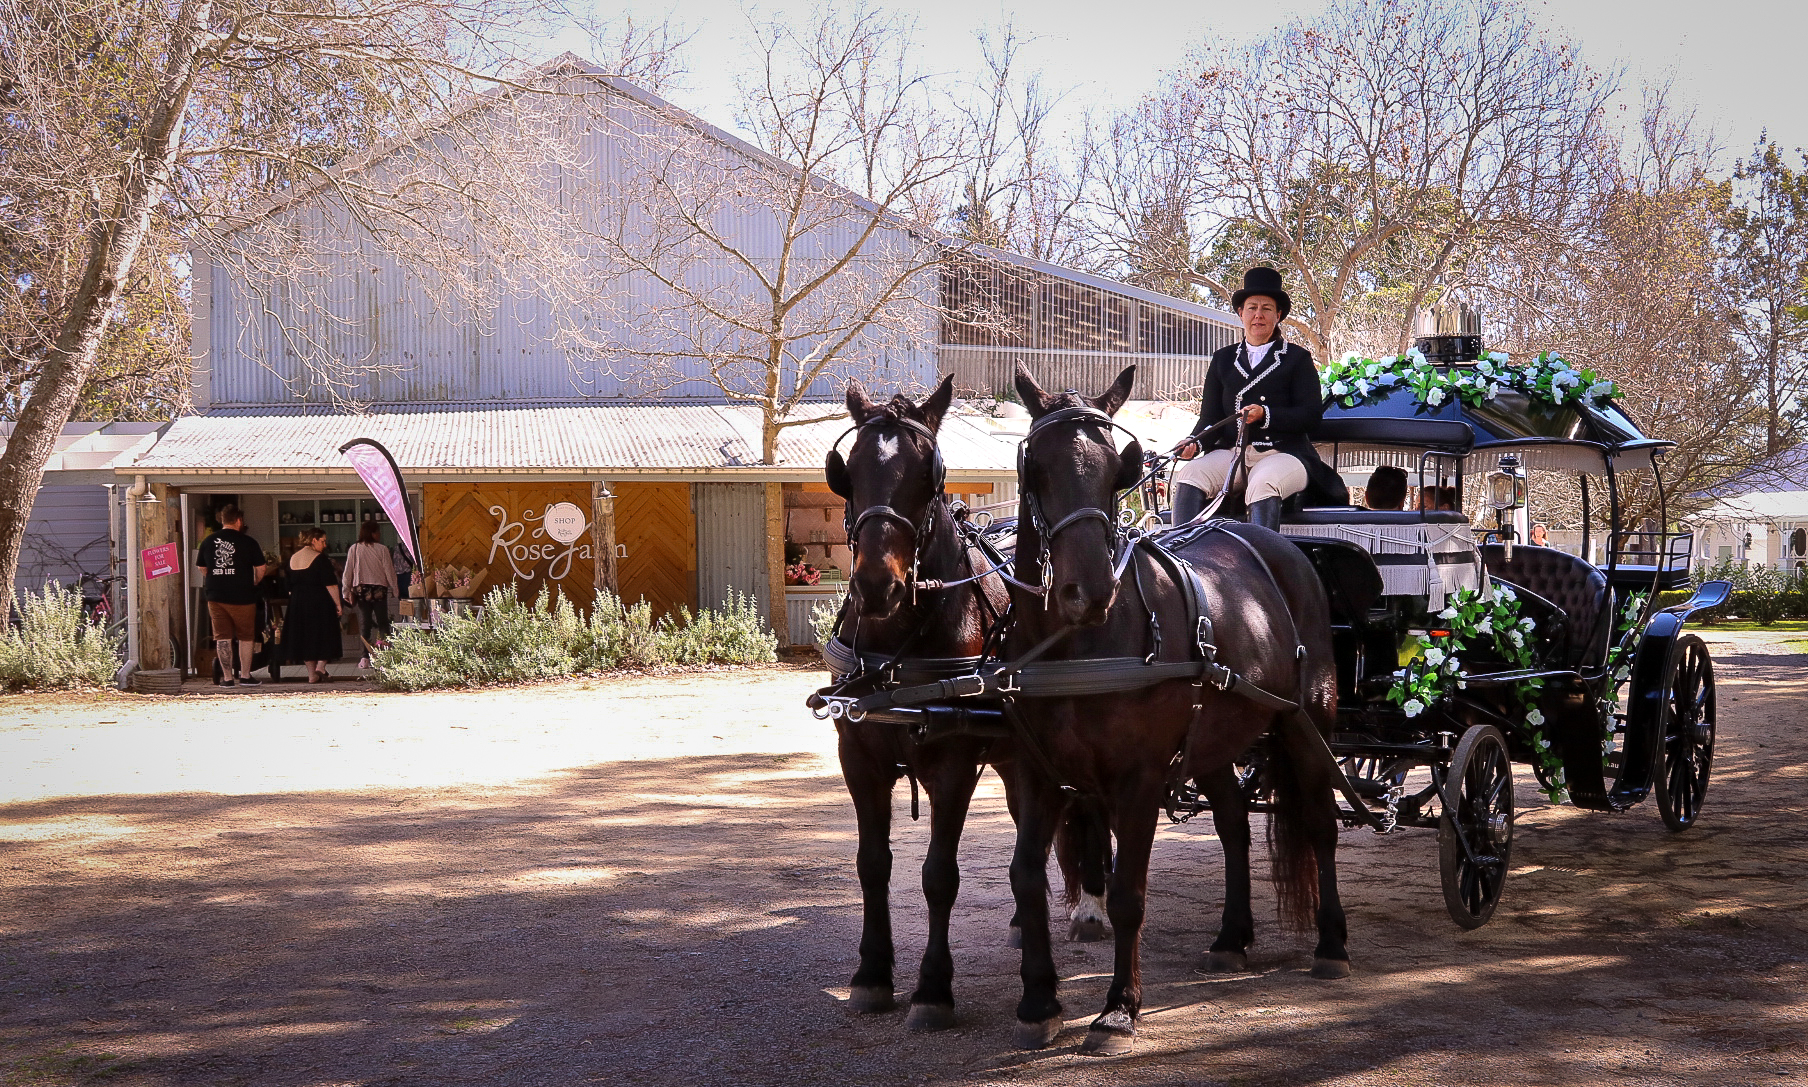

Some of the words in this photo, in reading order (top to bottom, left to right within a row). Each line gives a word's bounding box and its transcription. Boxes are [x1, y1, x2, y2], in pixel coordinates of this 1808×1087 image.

[554, 517, 576, 525] SHOP
[488, 505, 555, 580] Rose
[148, 547, 170, 556] FLOWERS
[155, 559, 166, 567] SALE
